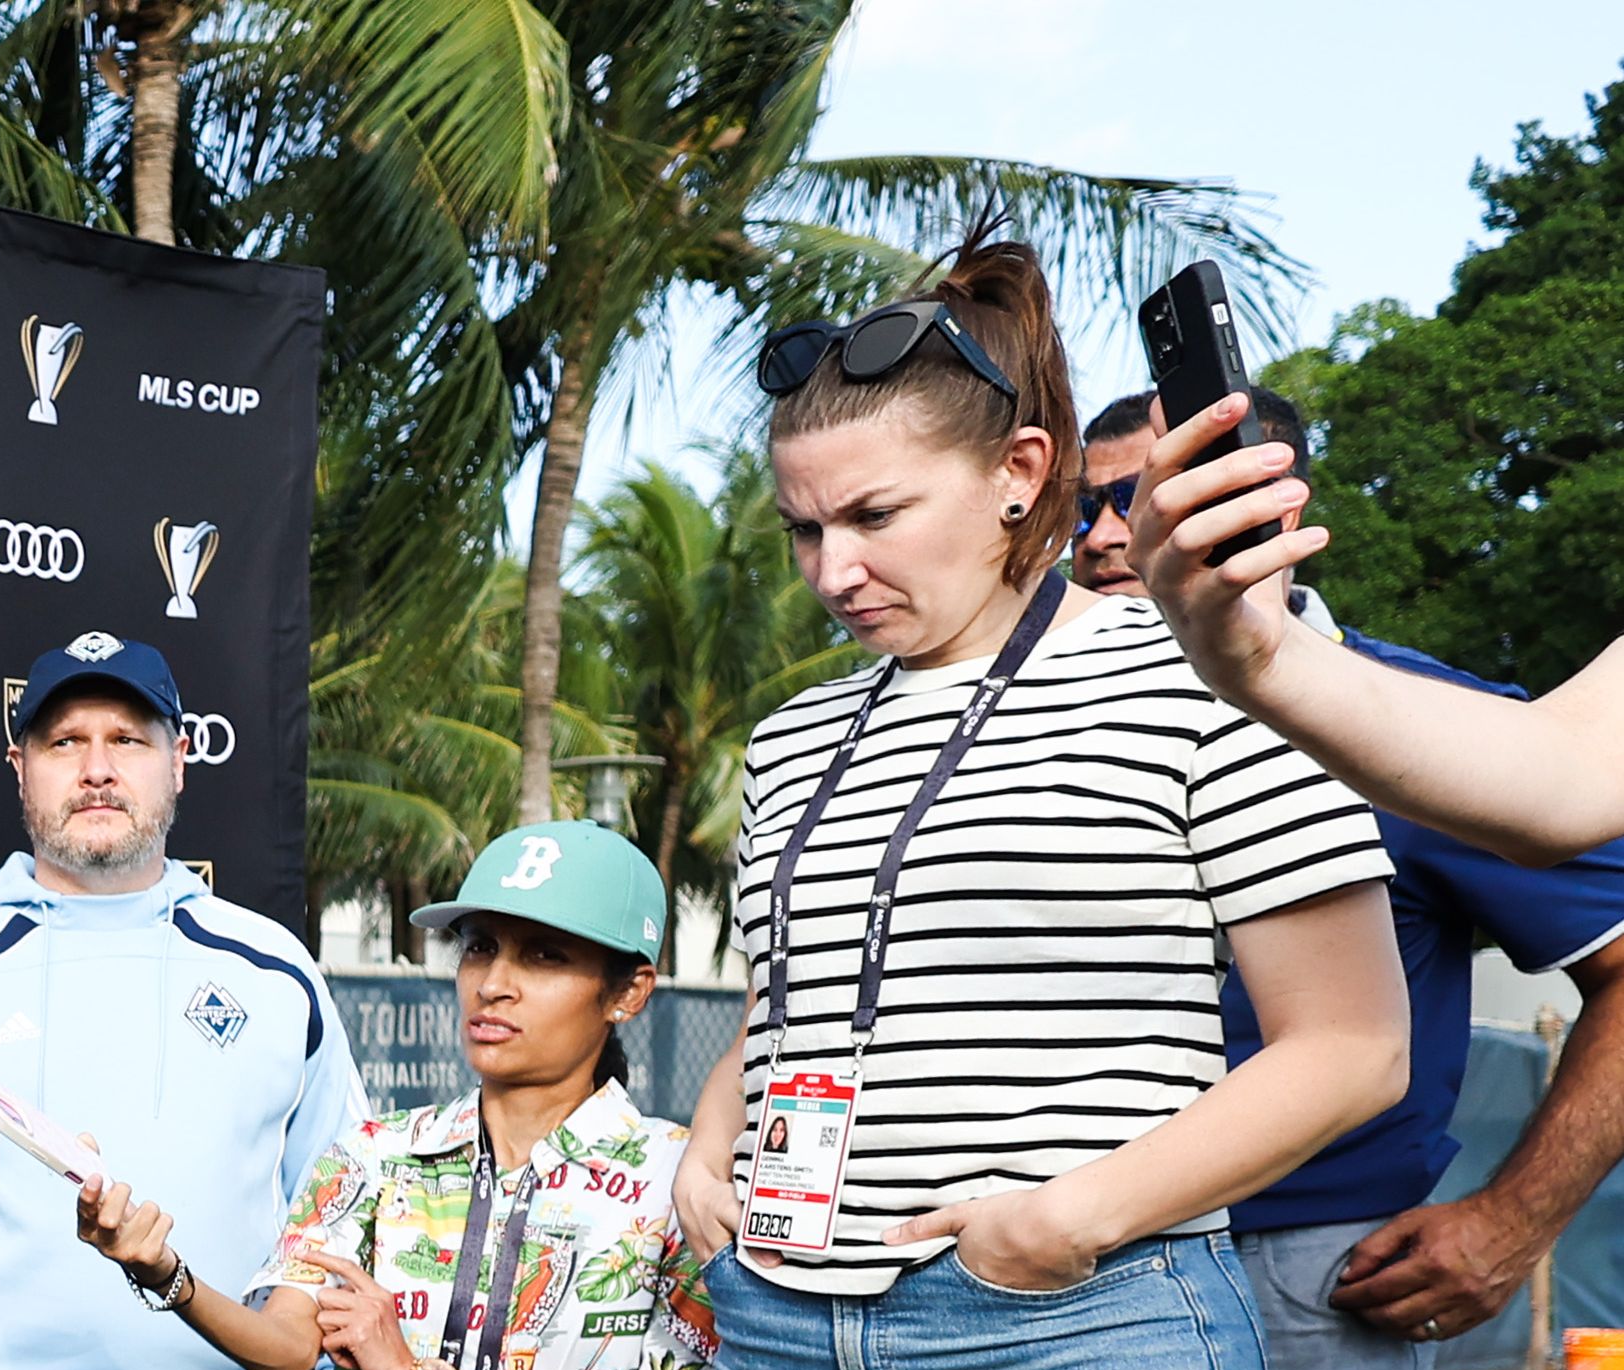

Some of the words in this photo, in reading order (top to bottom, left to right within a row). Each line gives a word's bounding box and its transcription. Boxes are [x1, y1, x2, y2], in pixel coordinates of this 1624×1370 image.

[138, 374, 195, 409] MLS
[197, 383, 260, 416] CUP
[500, 836, 563, 890] B
[358, 1002, 461, 1046] TOURN
[362, 1061, 458, 1088] FINALISTS
[393, 1290, 429, 1320] ED
